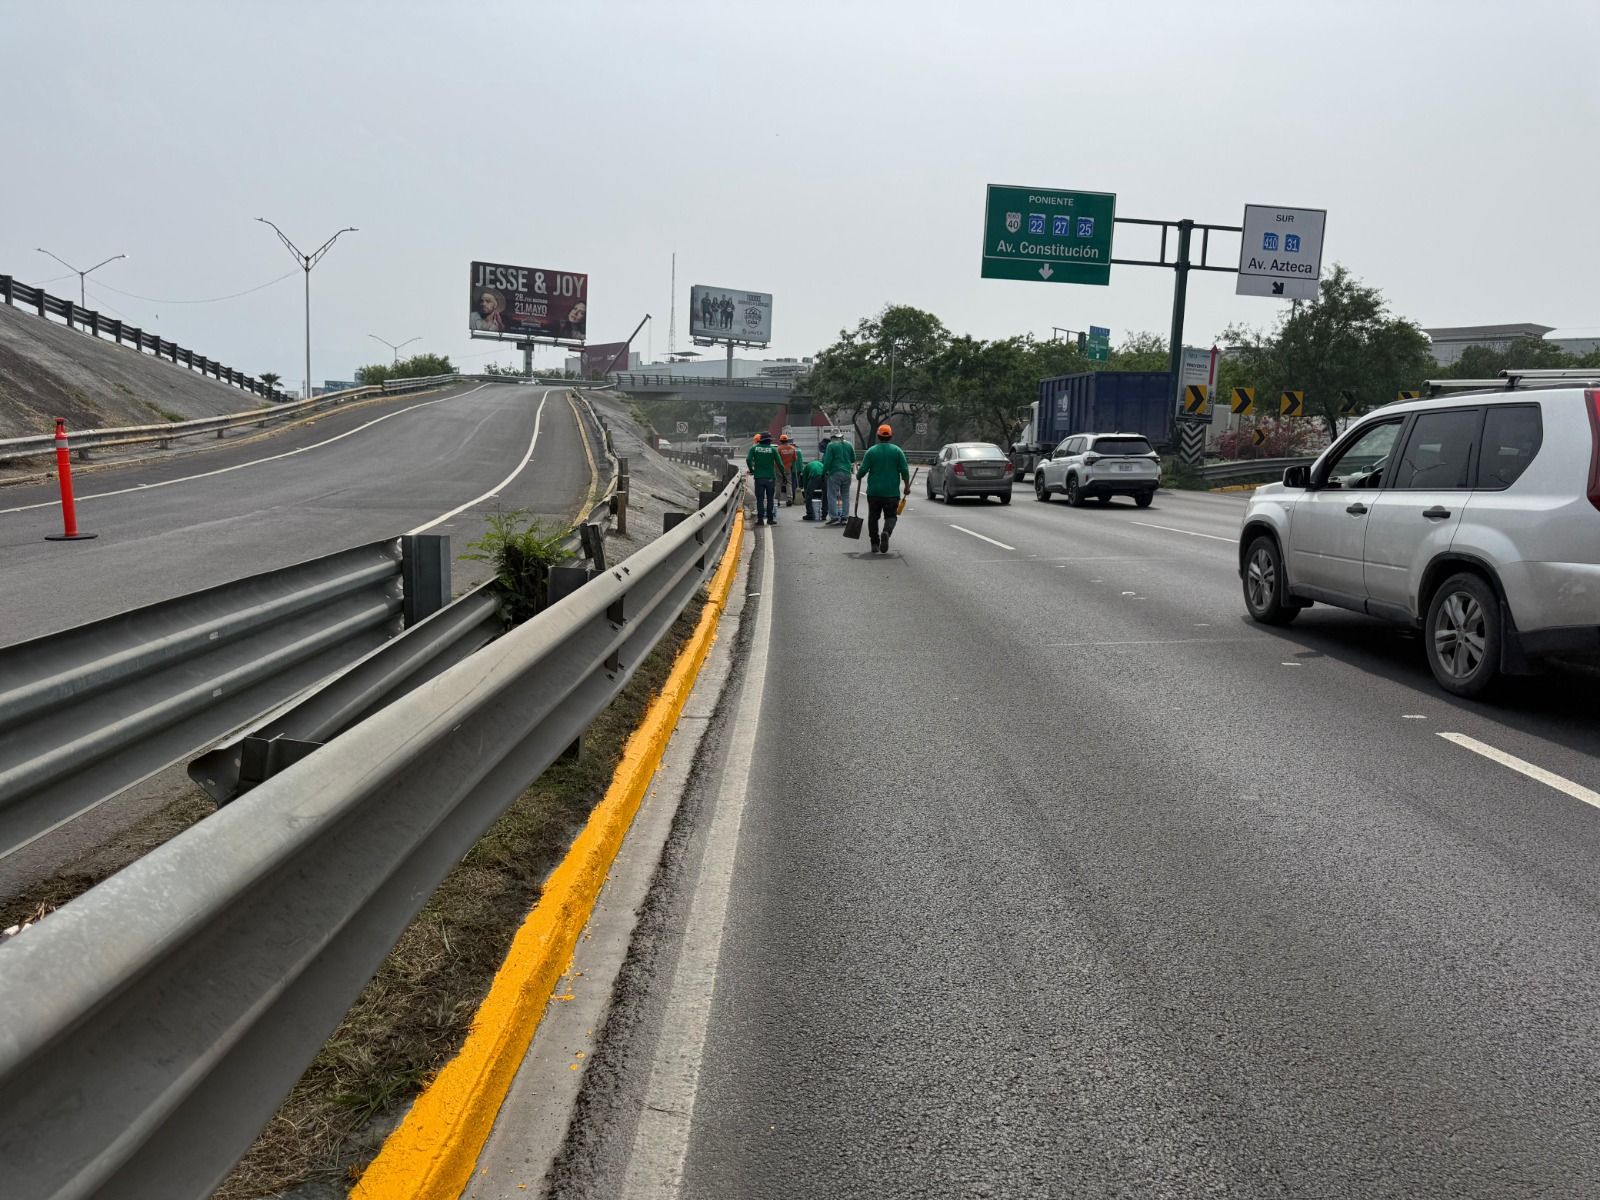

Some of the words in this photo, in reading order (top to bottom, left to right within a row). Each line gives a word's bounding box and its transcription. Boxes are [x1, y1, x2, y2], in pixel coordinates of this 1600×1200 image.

[1028, 195, 1075, 206] PONIENTE
[1275, 214, 1295, 223] SUR
[1007, 219, 1019, 230] 40
[1030, 220, 1043, 233] 22
[1055, 222, 1067, 234] 27
[1079, 223, 1092, 236] 25
[997, 240, 1016, 253] Av.
[1019, 241, 1099, 259] Constitución
[1286, 238, 1298, 251] 31
[1248, 257, 1266, 270] Av.
[1270, 258, 1313, 274] Azteca
[475, 265, 528, 292] JESSE
[534, 271, 548, 295] &
[553, 274, 585, 298] JOY
